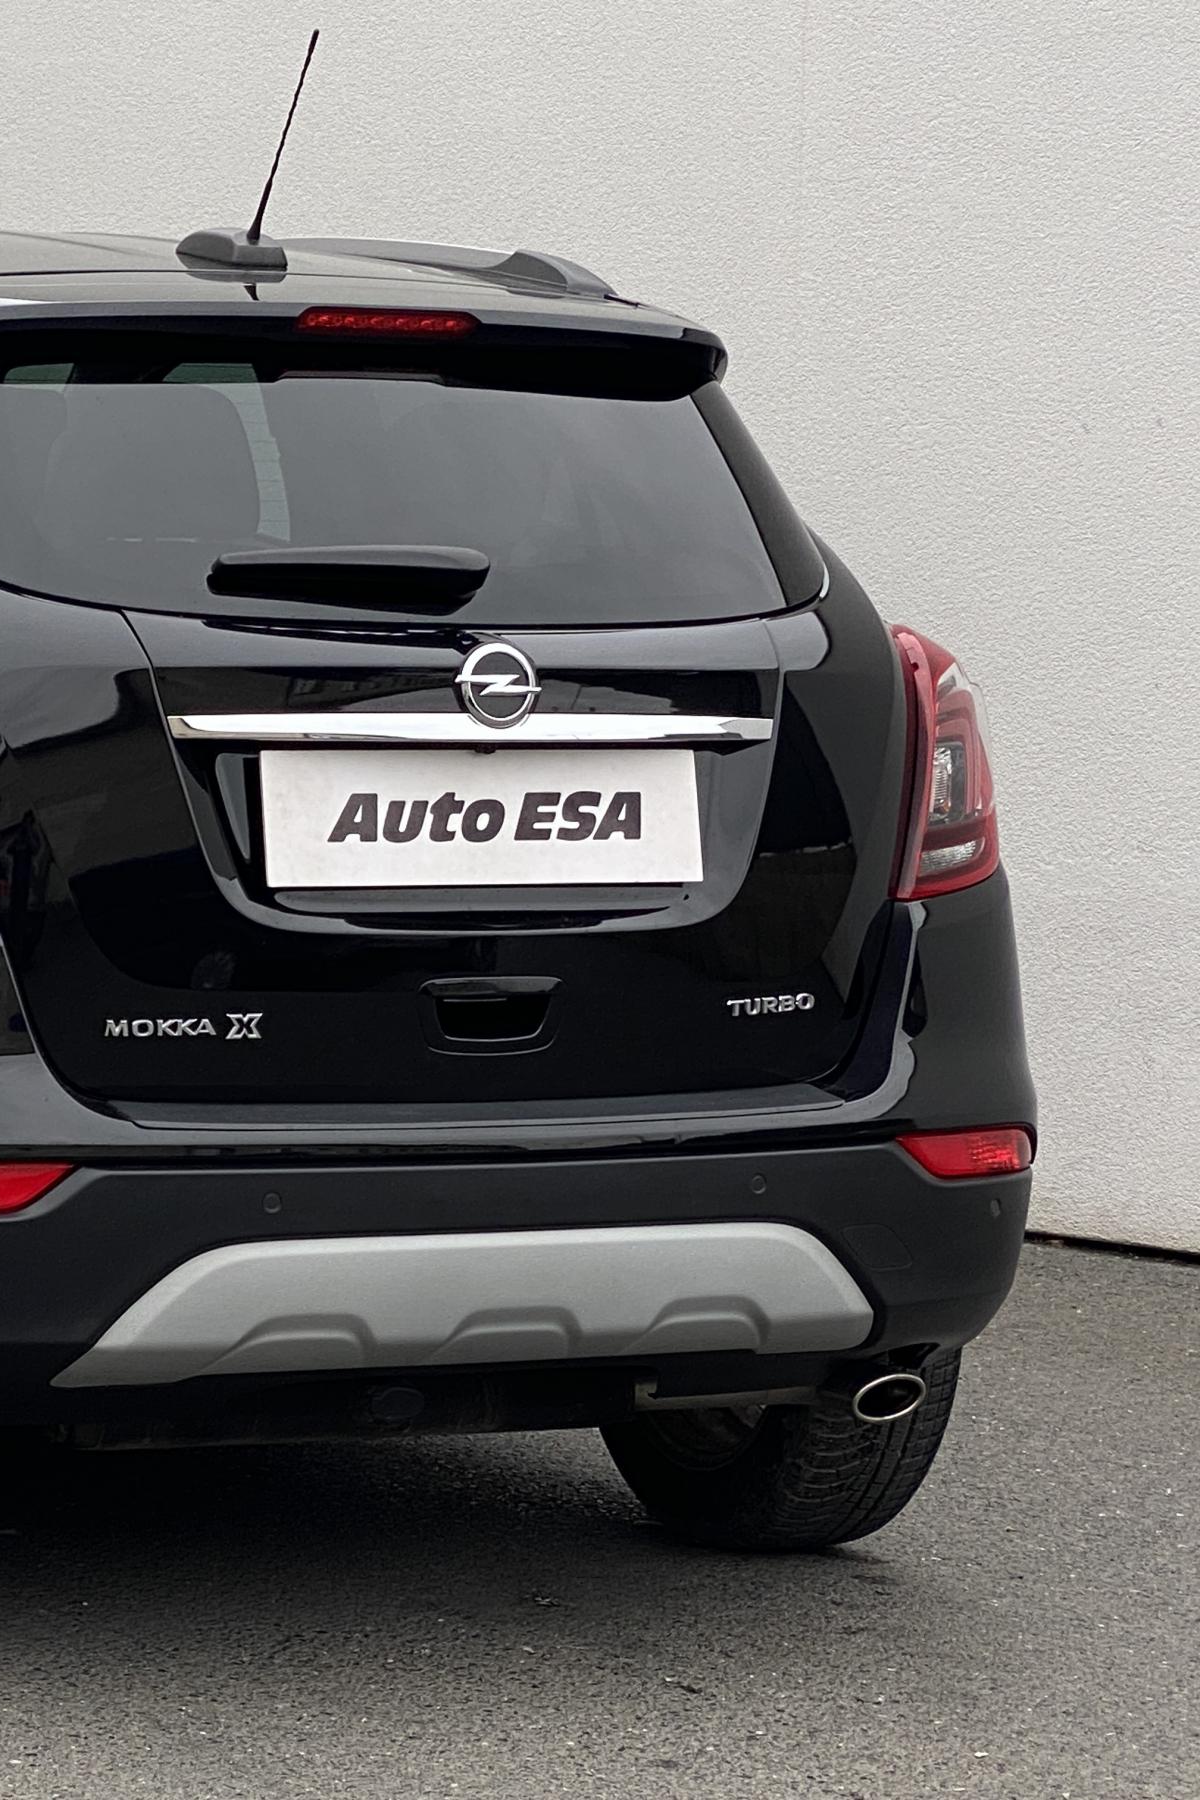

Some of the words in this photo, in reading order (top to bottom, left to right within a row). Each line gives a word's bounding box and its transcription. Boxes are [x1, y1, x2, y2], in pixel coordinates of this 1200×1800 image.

[327, 792, 505, 843] Auto
[514, 791, 641, 841] ESA
[726, 992, 815, 1017] TURBO
[104, 1018, 217, 1037] MOKKA
[225, 1013, 264, 1039] X
